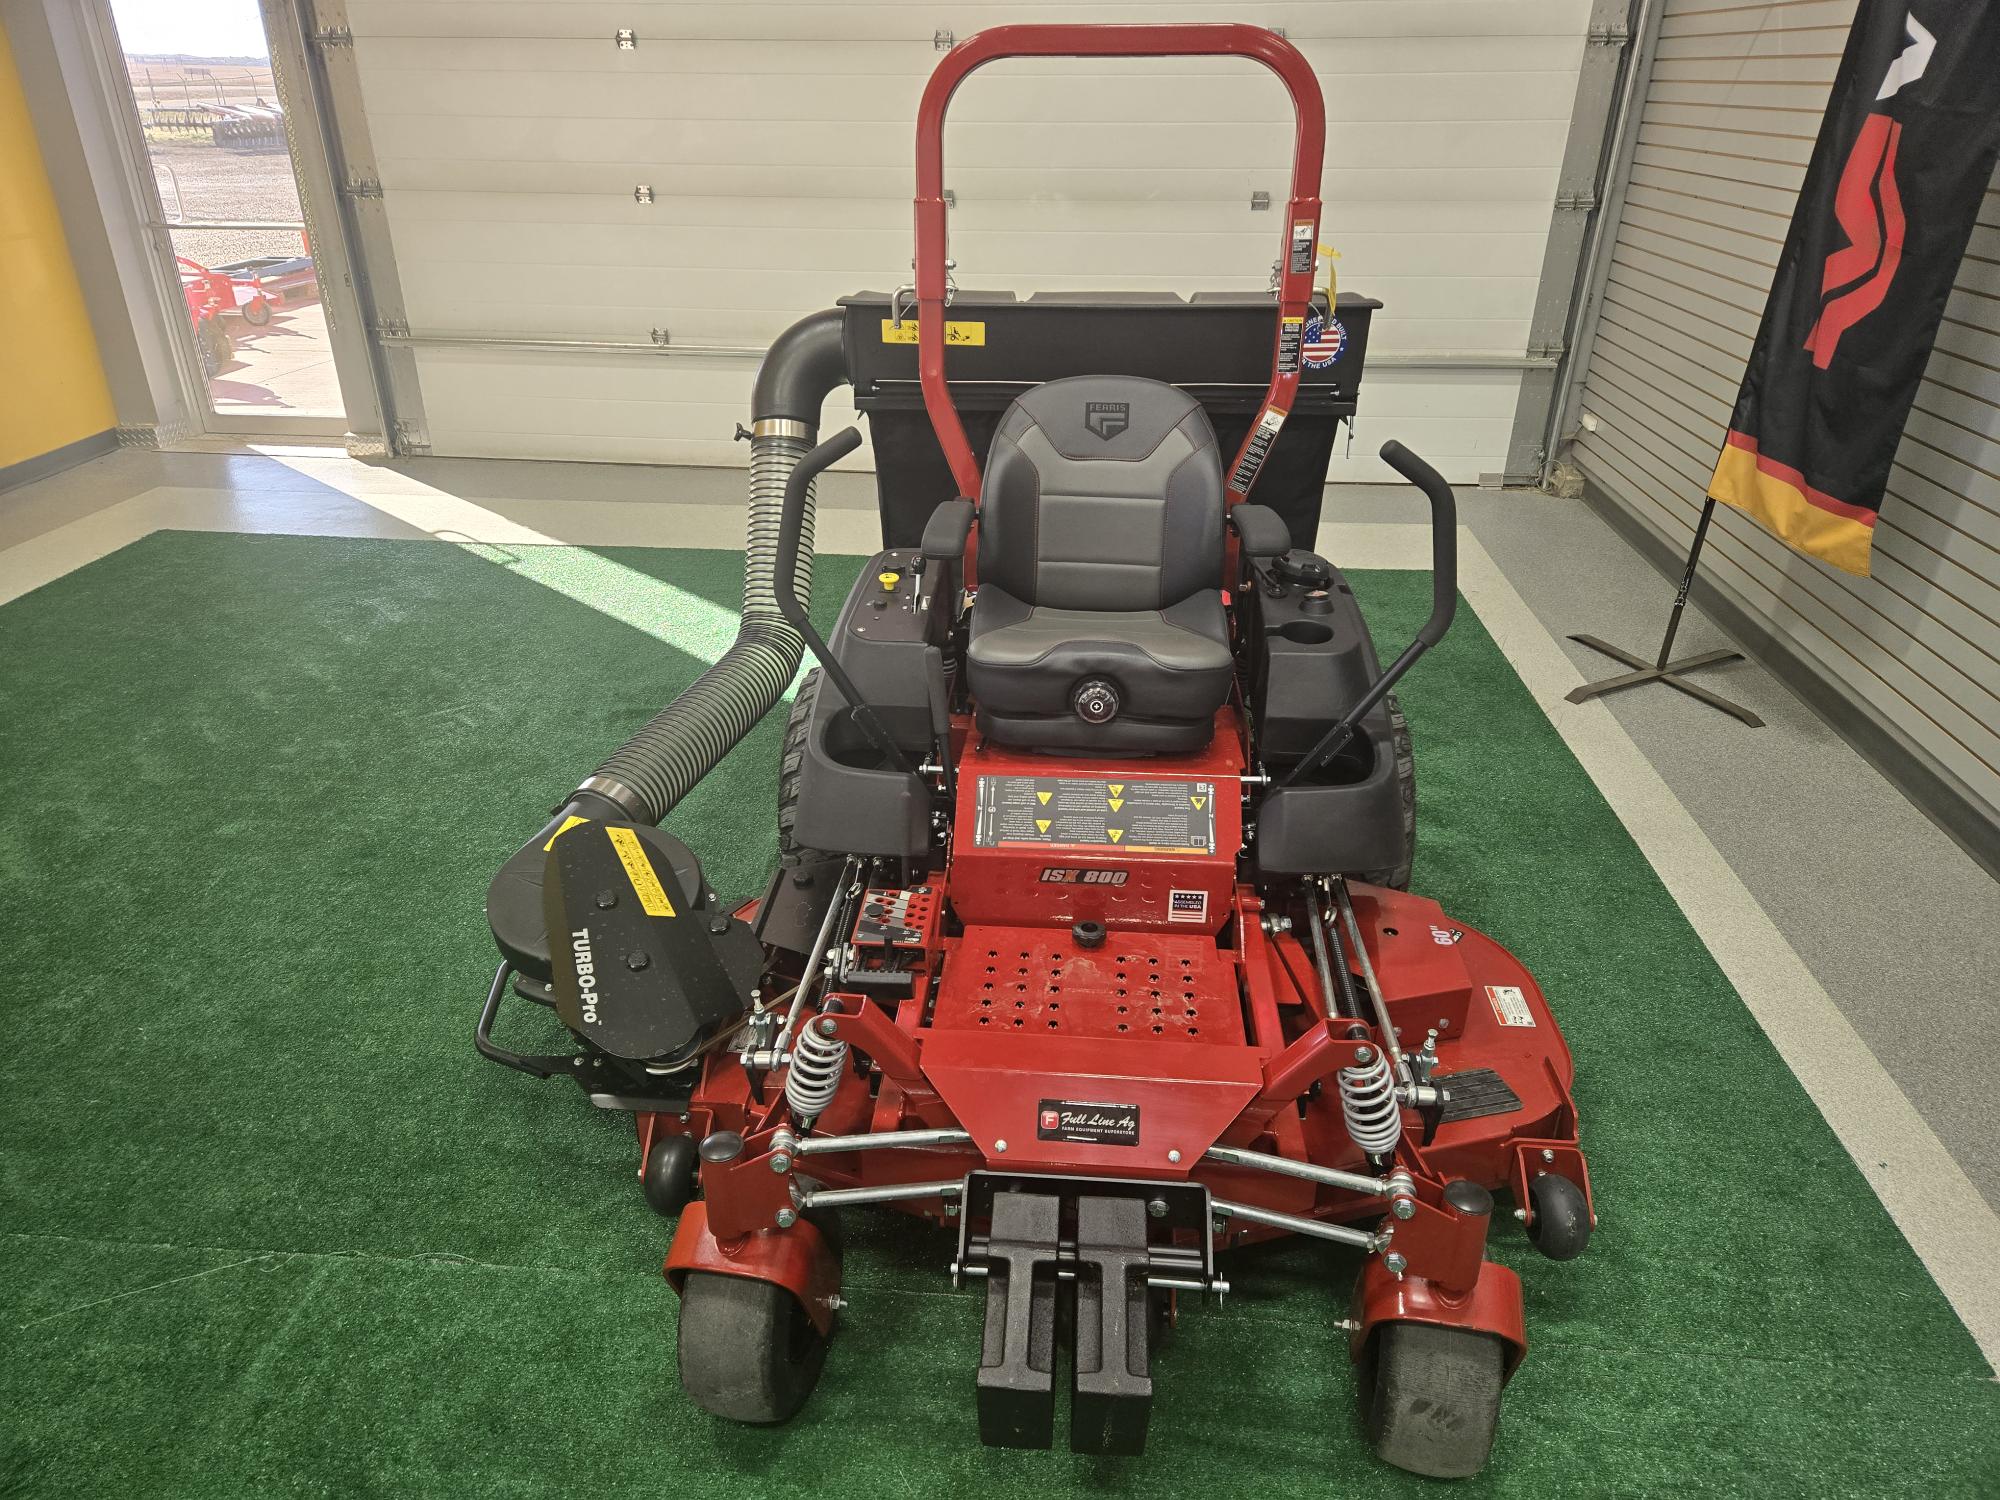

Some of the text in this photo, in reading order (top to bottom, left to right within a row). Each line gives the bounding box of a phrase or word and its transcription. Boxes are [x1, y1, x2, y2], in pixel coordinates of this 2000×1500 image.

[1336, 322, 1347, 340] BUILT
[1322, 357, 1337, 368] USA
[1089, 403, 1126, 412] FERRIS
[1041, 868, 1127, 885] ISX 800
[1045, 1115, 1055, 1126] F
[1060, 1111, 1136, 1131] Full Line Ag
